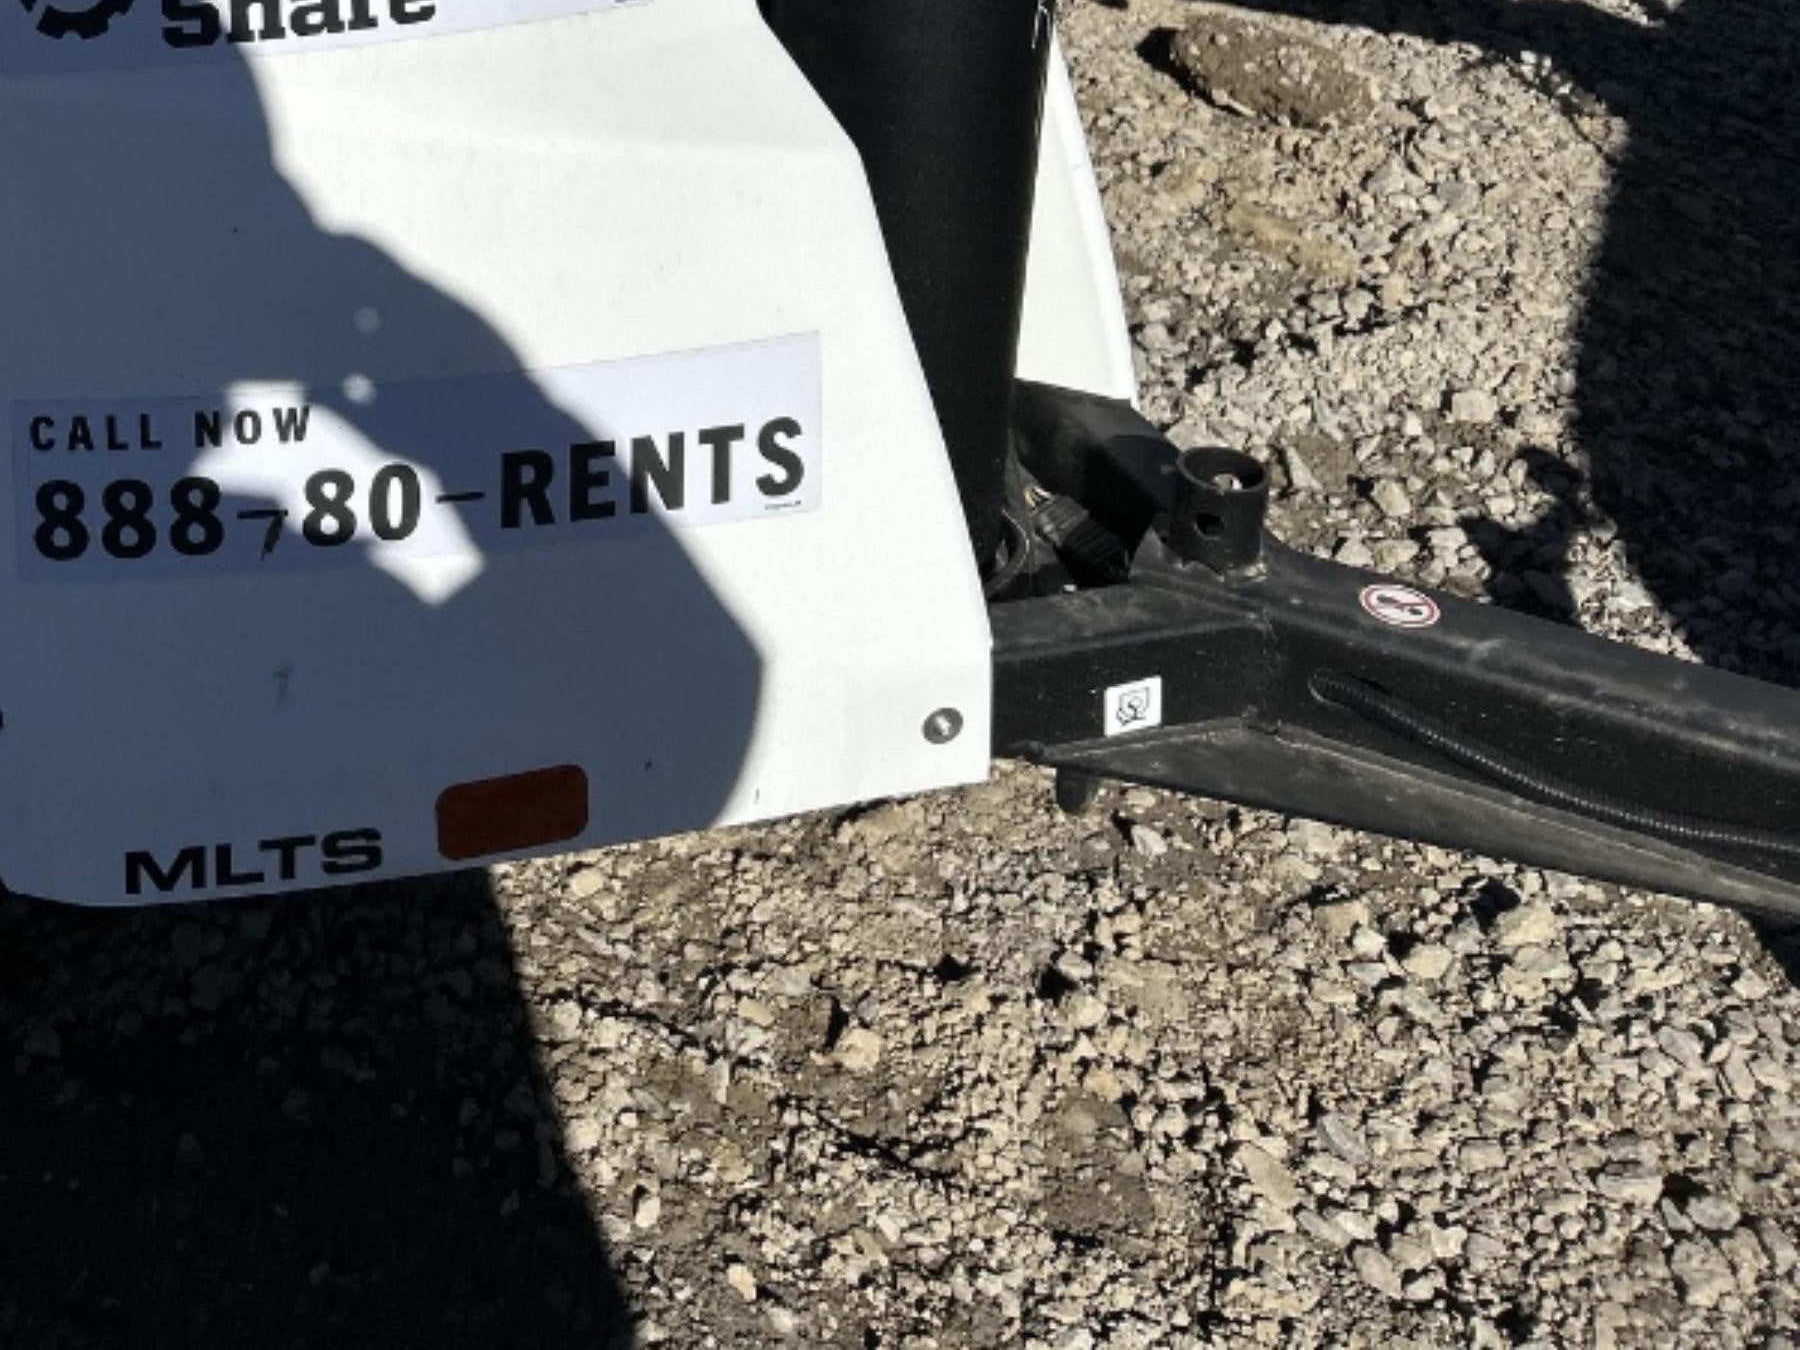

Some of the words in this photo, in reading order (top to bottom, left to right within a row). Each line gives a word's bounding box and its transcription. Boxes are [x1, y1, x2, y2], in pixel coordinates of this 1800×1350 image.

[29, 414, 163, 452] CALL
[193, 405, 312, 448] NOW
[33, 416, 806, 562] 888-80-RENTS
[123, 826, 384, 895] MLTS
